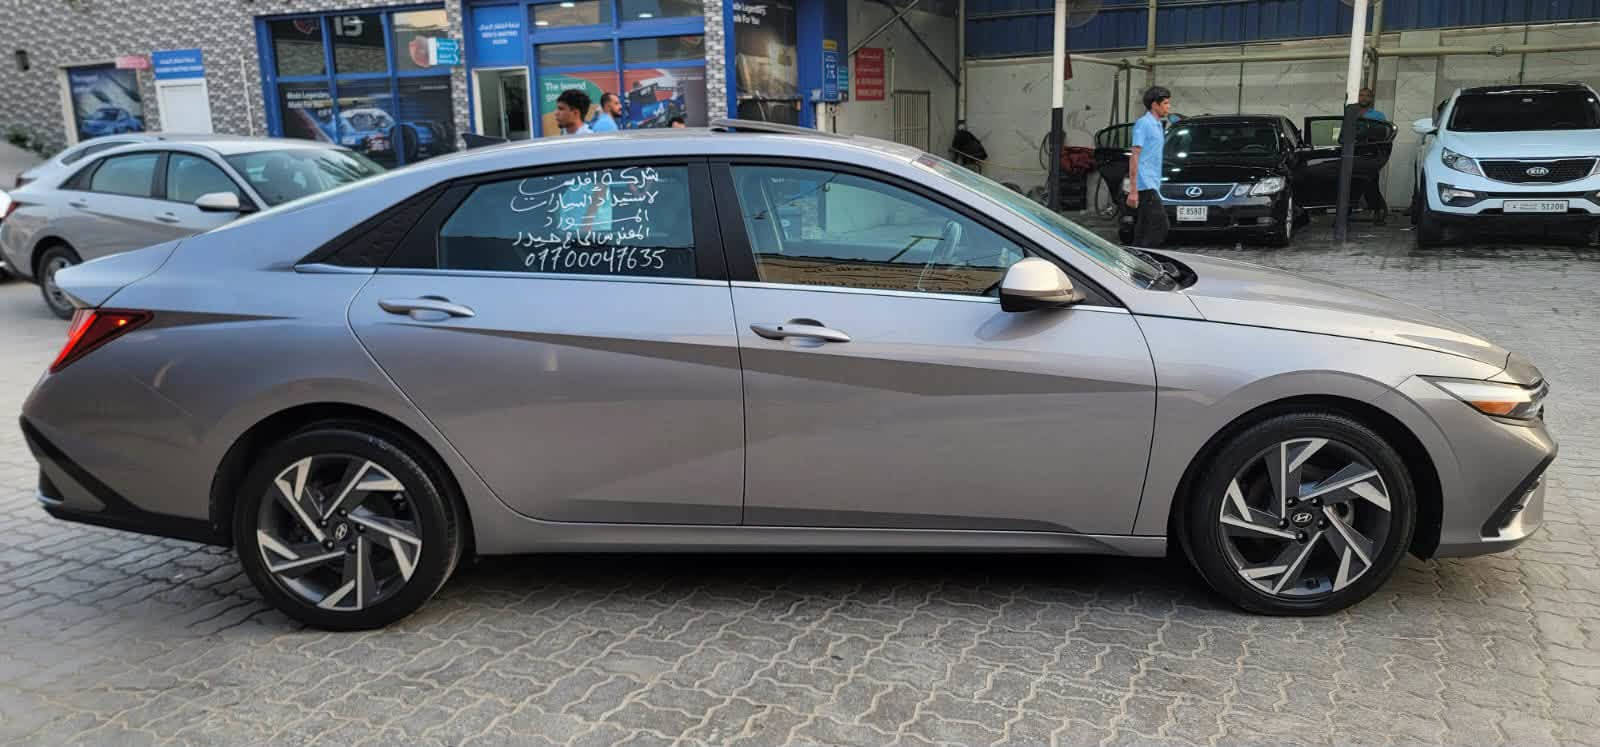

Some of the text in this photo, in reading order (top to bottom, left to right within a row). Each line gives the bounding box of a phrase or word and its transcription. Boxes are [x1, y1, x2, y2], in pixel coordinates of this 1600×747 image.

[544, 82, 559, 90] The
[600, 167, 659, 188] شركة
[1528, 167, 1547, 176] KIA
[510, 193, 593, 212] السيارات
[512, 231, 562, 247] حيدر
[525, 246, 666, 273] 07700047635
